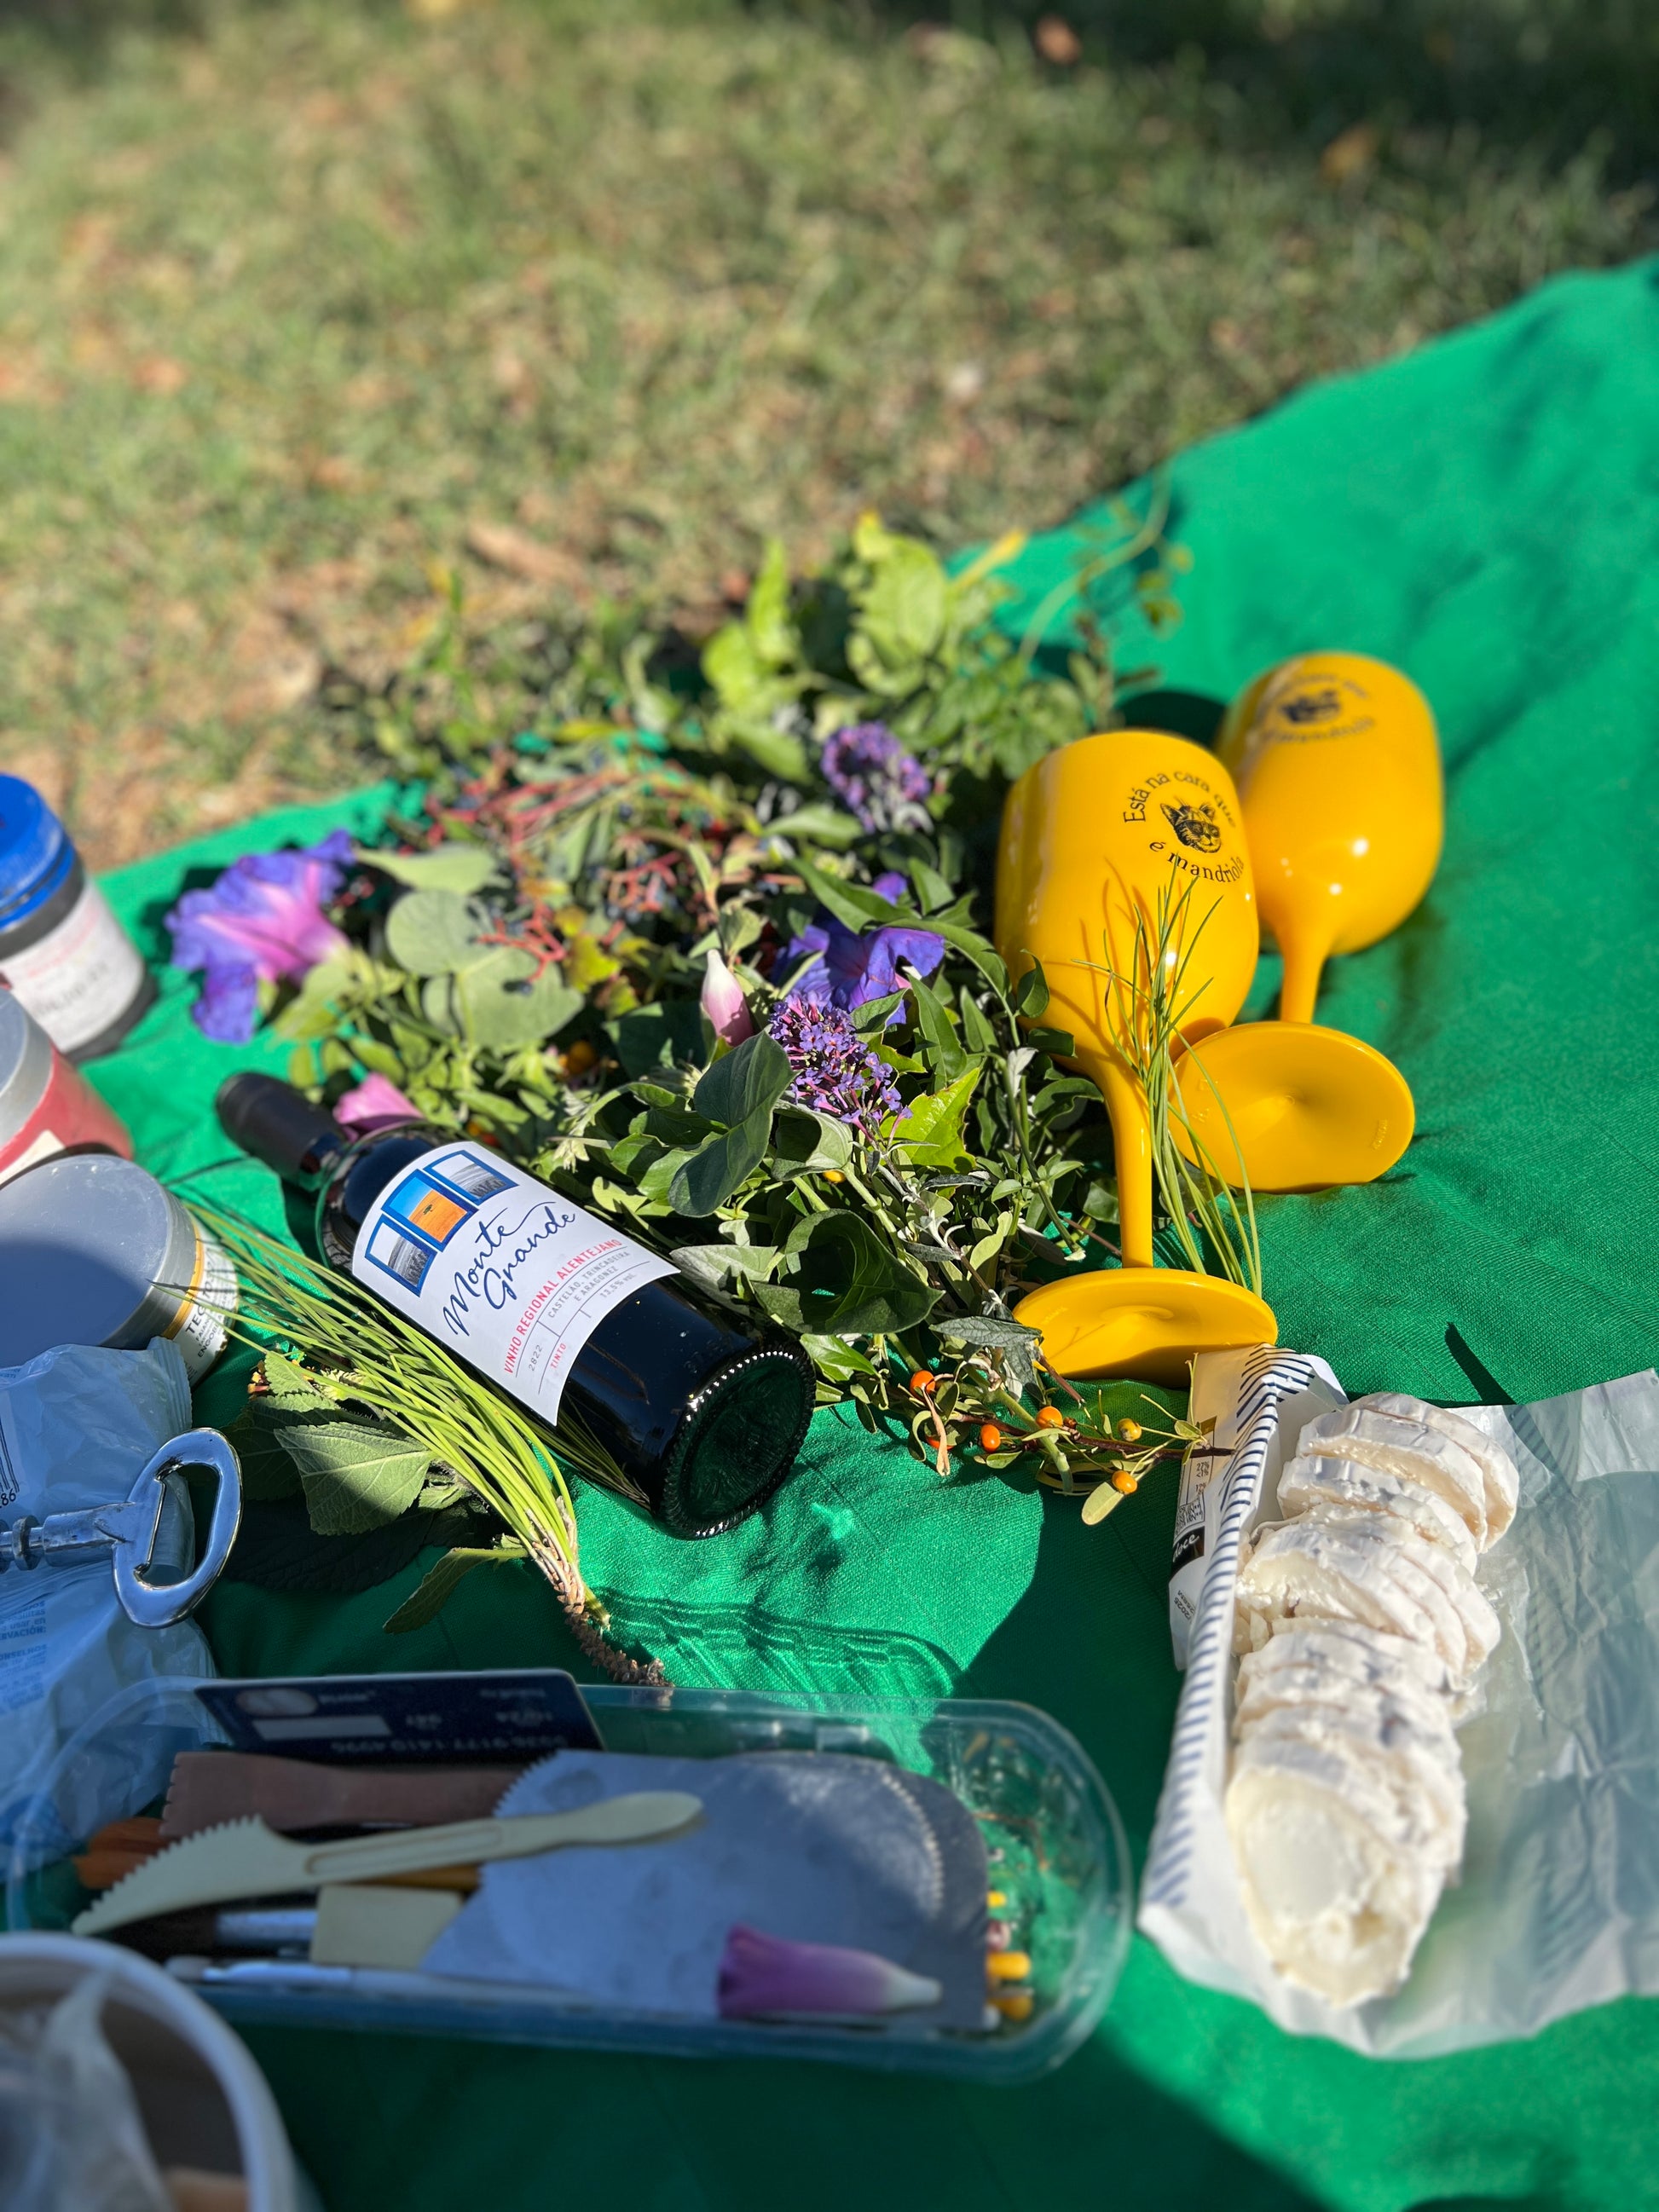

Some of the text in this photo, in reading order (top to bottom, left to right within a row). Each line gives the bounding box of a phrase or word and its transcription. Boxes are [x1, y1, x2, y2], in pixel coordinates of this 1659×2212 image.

[1123, 771, 1235, 828] Está na cara que
[1149, 840, 1245, 883] é mandriola
[443, 1202, 556, 1336] Monte
[484, 1206, 575, 1309] Grande
[582, 1251, 630, 1280] TRINCADEIRA
[581, 1266, 619, 1296] ARAGONEZ
[505, 1239, 622, 1373] VINHO REGIONAL ALENTEJANO
[551, 1343, 567, 1370] TINTO
[0, 1492, 16, 1508] 86
